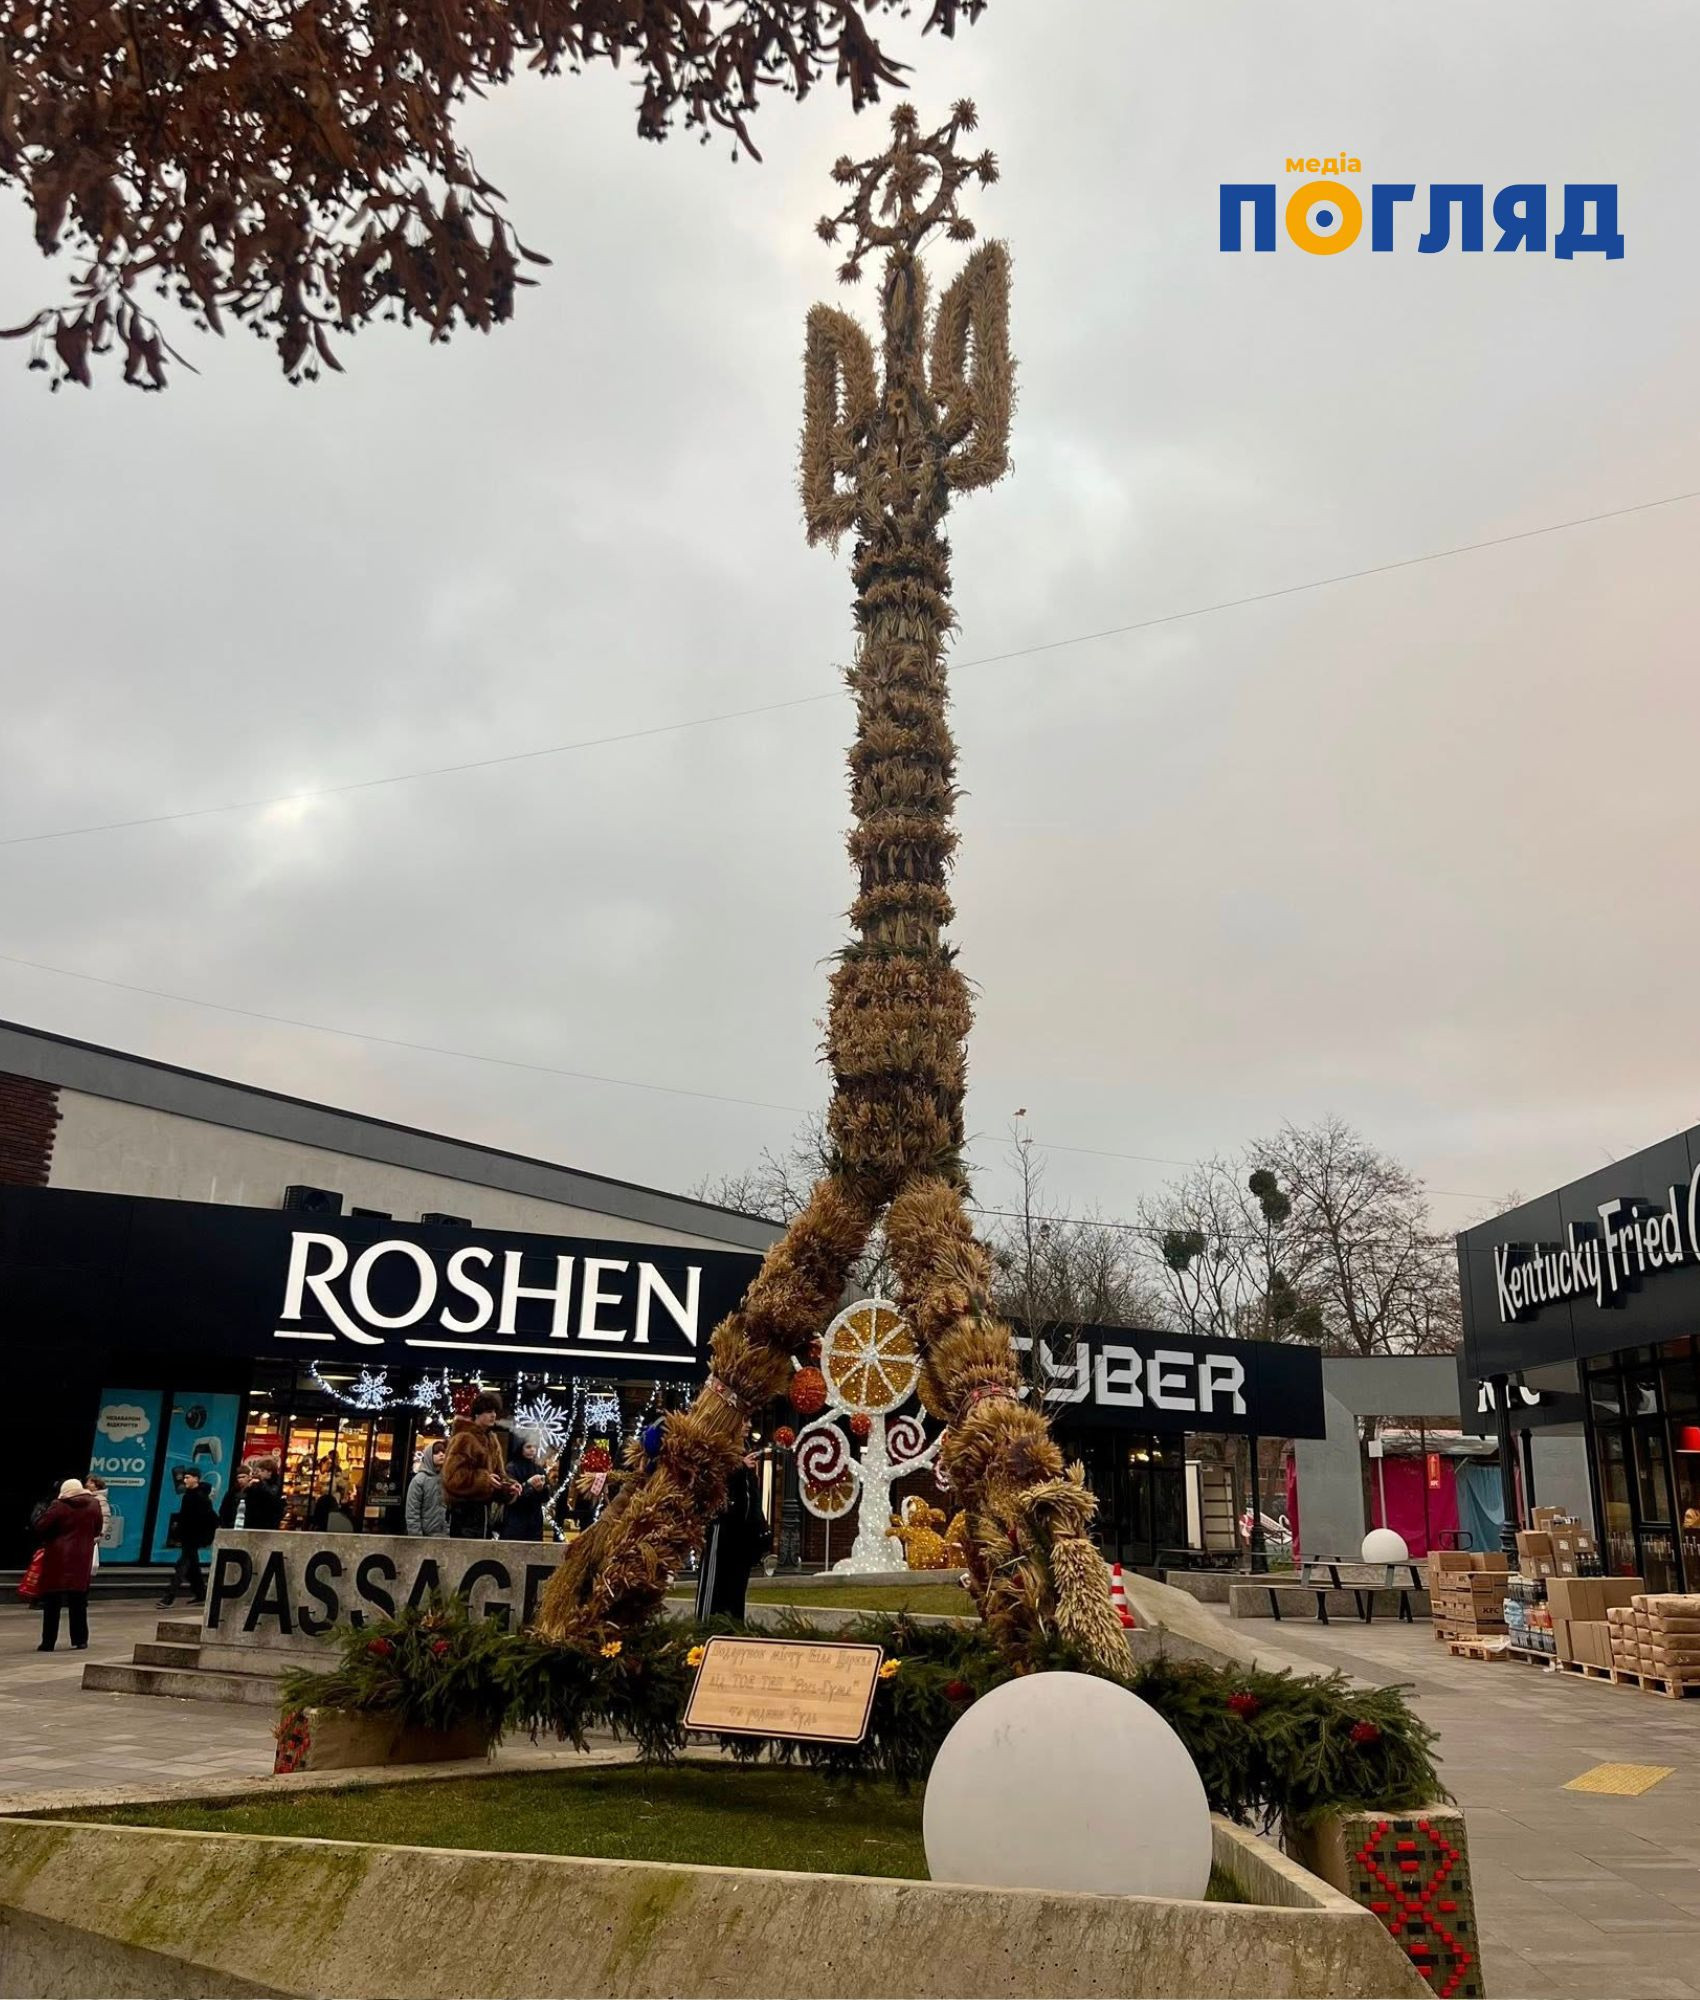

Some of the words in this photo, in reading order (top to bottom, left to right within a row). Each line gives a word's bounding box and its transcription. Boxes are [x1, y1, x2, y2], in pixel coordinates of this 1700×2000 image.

[279, 1230, 702, 1347] ROSHEN
[1493, 1221, 1602, 1322] Kentucky
[1597, 1185, 1684, 1292] Fried
[89, 1456, 146, 1472] MOYO
